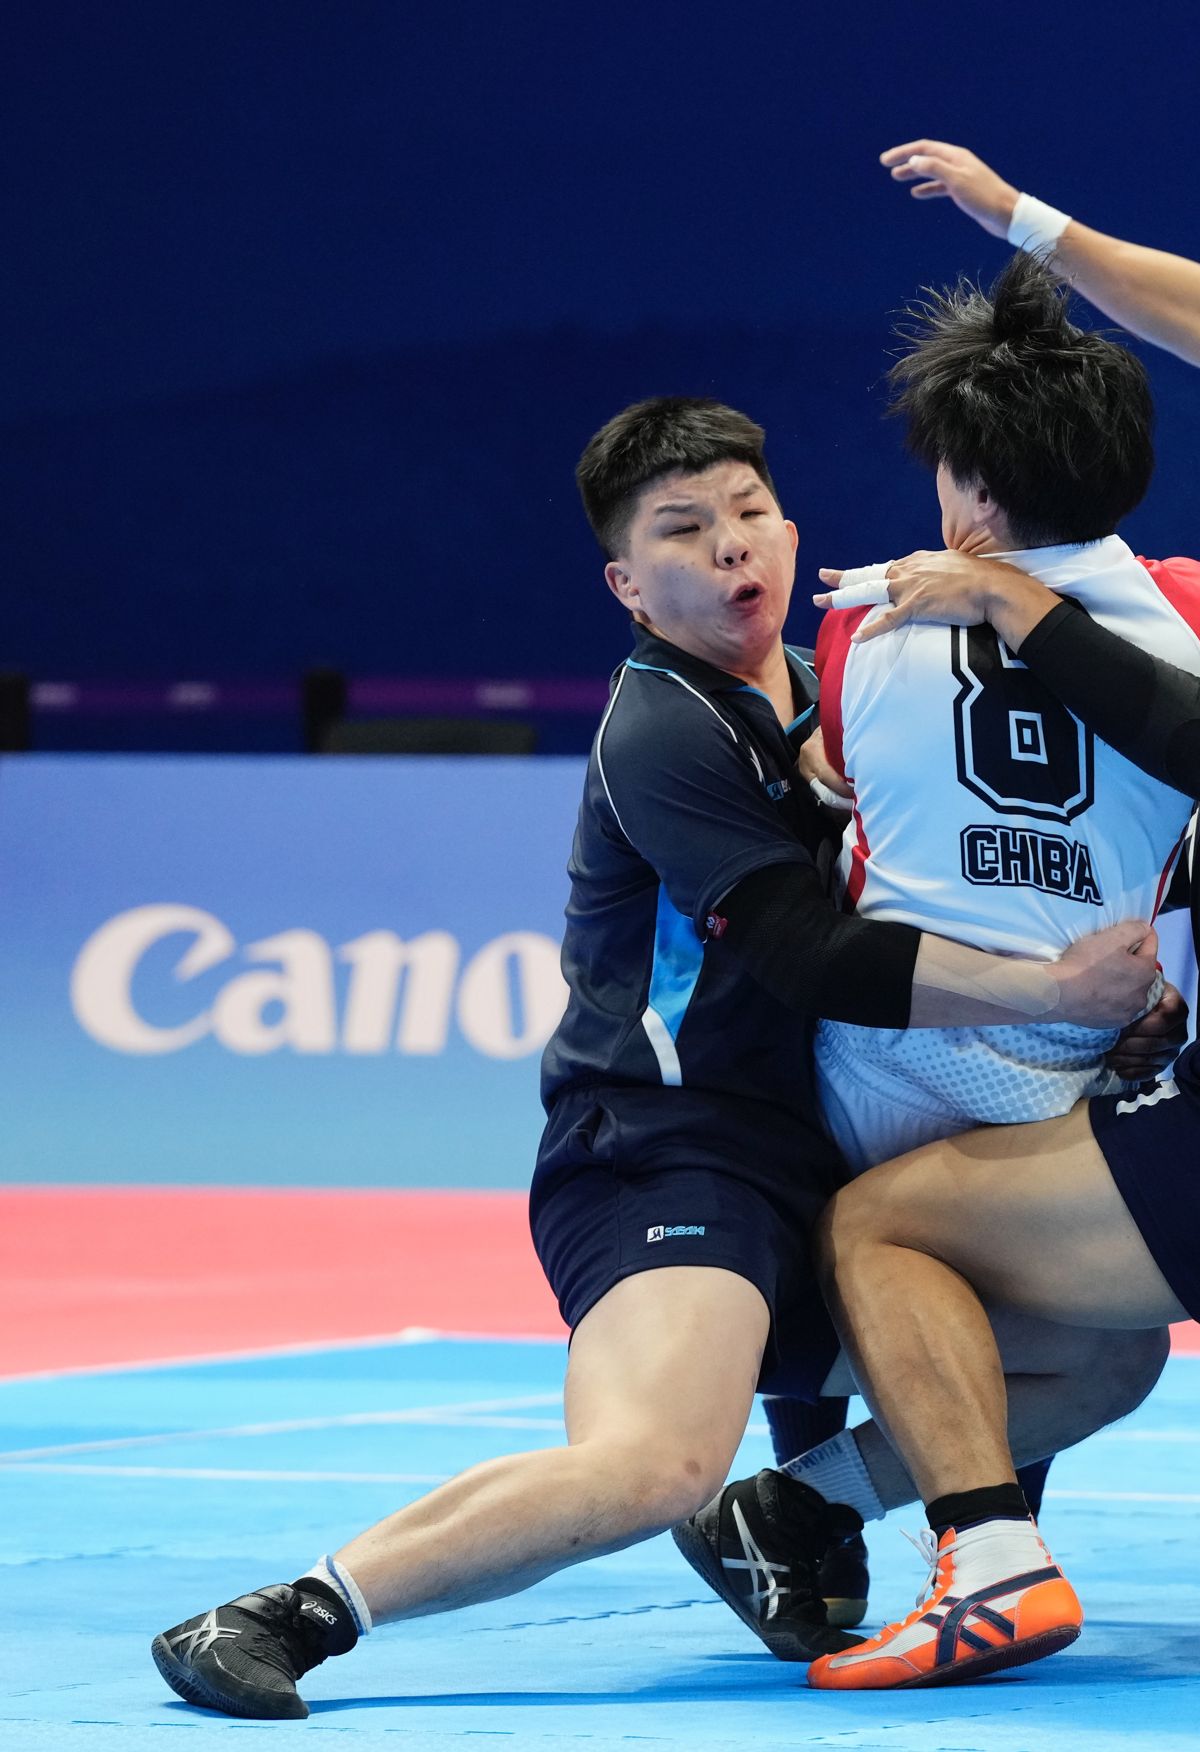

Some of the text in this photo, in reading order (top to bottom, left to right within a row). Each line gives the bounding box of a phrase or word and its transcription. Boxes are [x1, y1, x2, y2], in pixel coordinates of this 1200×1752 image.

[950, 622, 1095, 826] 8
[959, 824, 1104, 906] CHIBA
[69, 902, 566, 1060] Cano
[312, 1604, 338, 1626] asics
